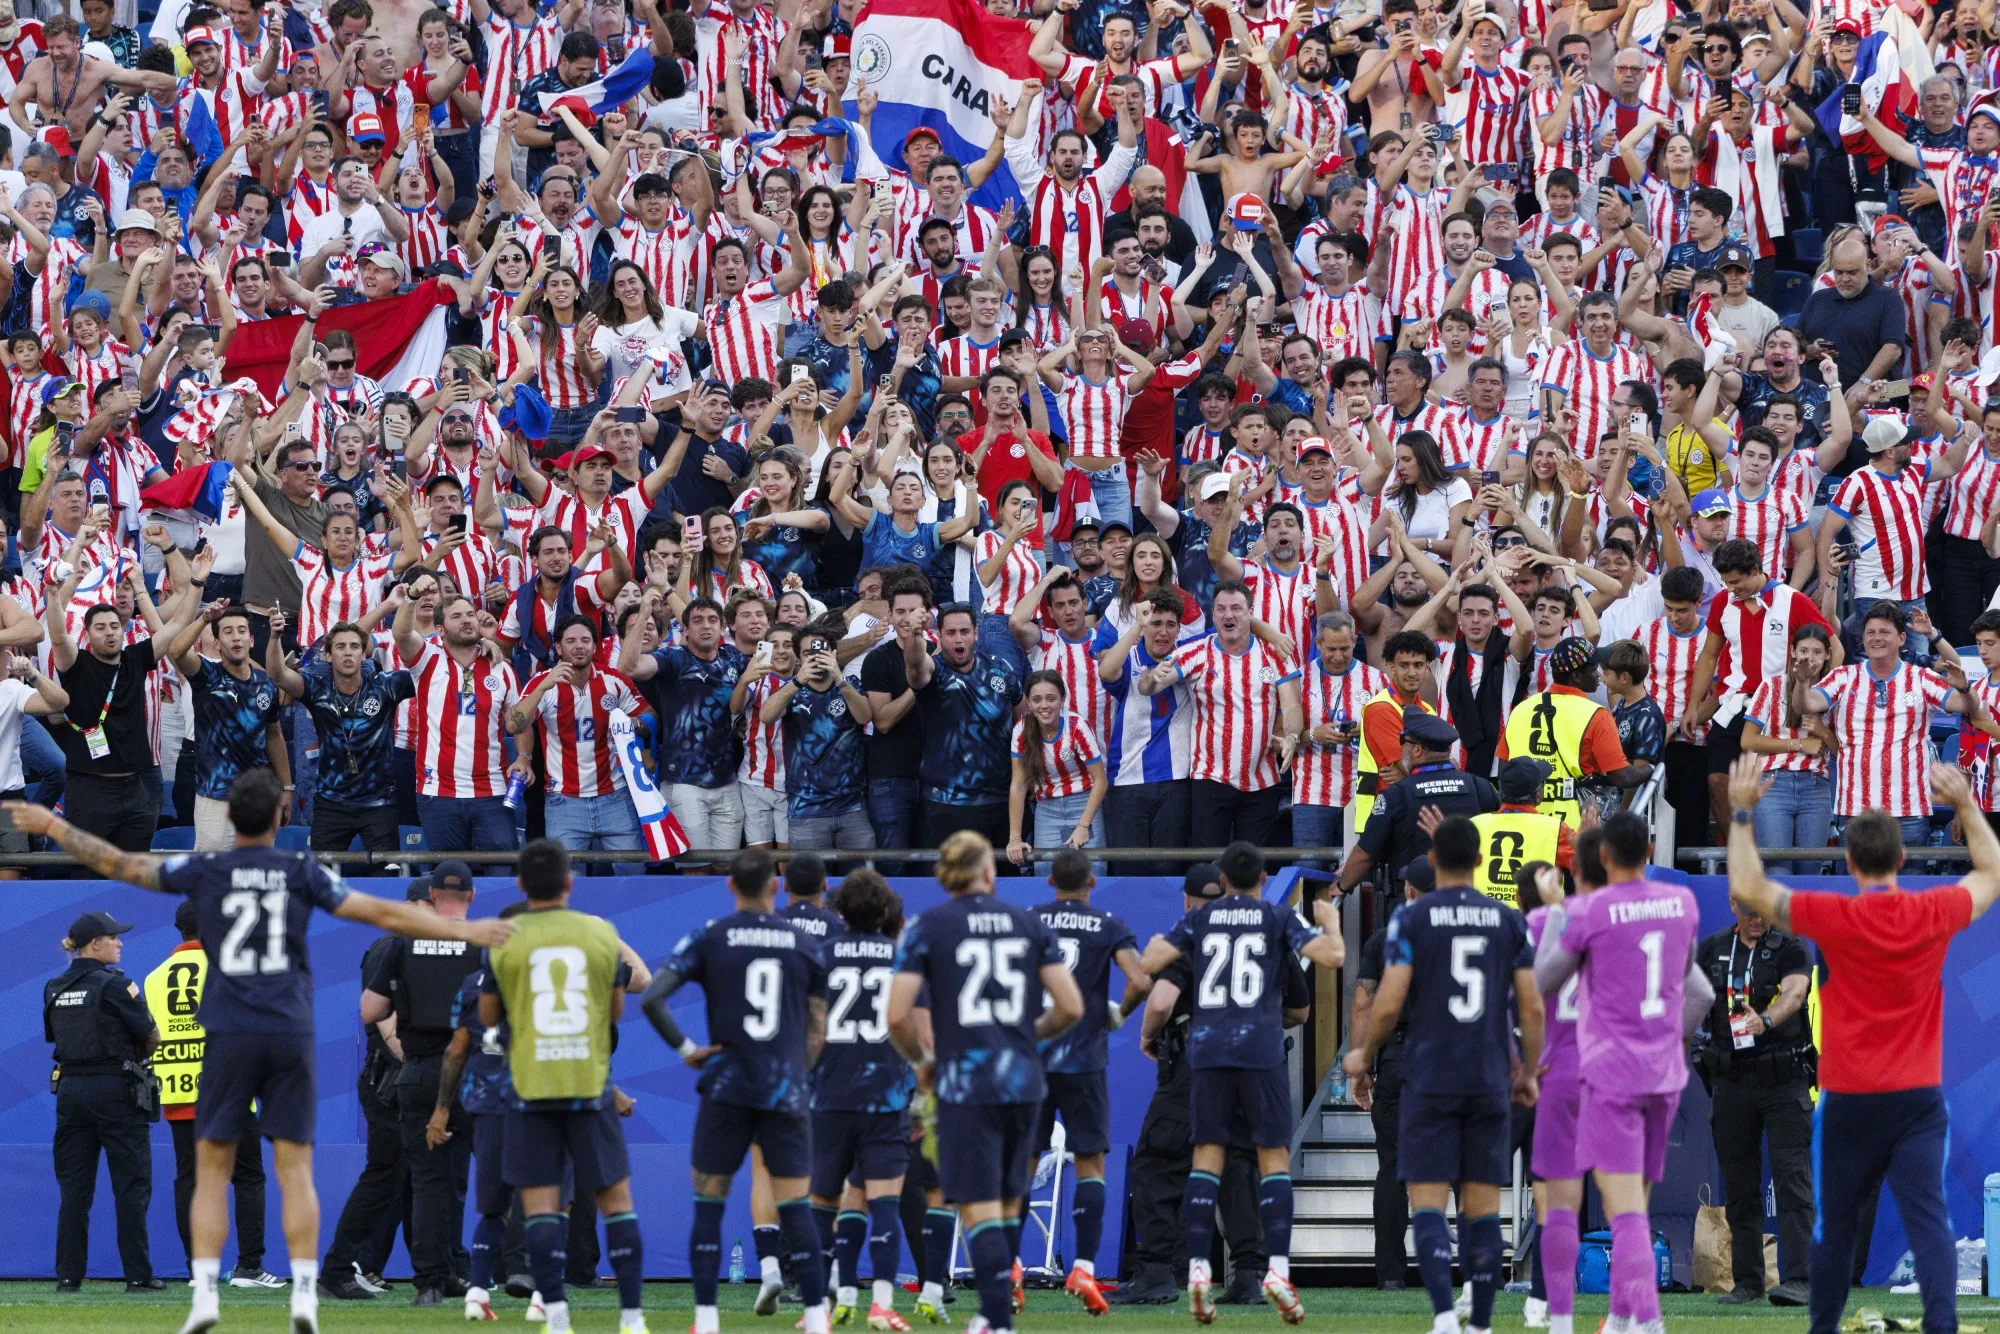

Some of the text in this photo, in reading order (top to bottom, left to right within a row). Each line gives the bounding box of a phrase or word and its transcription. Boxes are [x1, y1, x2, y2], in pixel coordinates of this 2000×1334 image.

[1064, 212, 1080, 232] 12
[457, 692, 477, 715] 12
[575, 715, 597, 742] 12
[611, 722, 637, 735] GALA
[1536, 744, 1551, 753] FIFA
[627, 741, 654, 792] 8
[1416, 780, 1465, 790] NEEDHAM
[1425, 785, 1459, 794] POLICE
[1497, 873, 1512, 881] FIFA
[967, 912, 1014, 934] PITTA
[1209, 908, 1263, 926] MAIDANA
[1429, 905, 1501, 928] BALBUENA
[219, 889, 291, 977] 21
[727, 927, 796, 949] SANABRIA
[413, 939, 467, 952] STATE POLICE
[413, 947, 467, 955] SERT
[834, 941, 894, 959] GALARZA
[1199, 932, 1267, 1009] 26
[1448, 935, 1490, 1023] 5
[1639, 929, 1666, 1020] 1
[956, 937, 1031, 1028] 25
[56, 998, 84, 1006] POLICE
[176, 1003, 191, 1012] FIFA
[743, 957, 783, 1041] 9
[826, 966, 893, 1044] 23
[168, 1022, 200, 1032] 2026
[150, 1041, 207, 1062] ECURI
